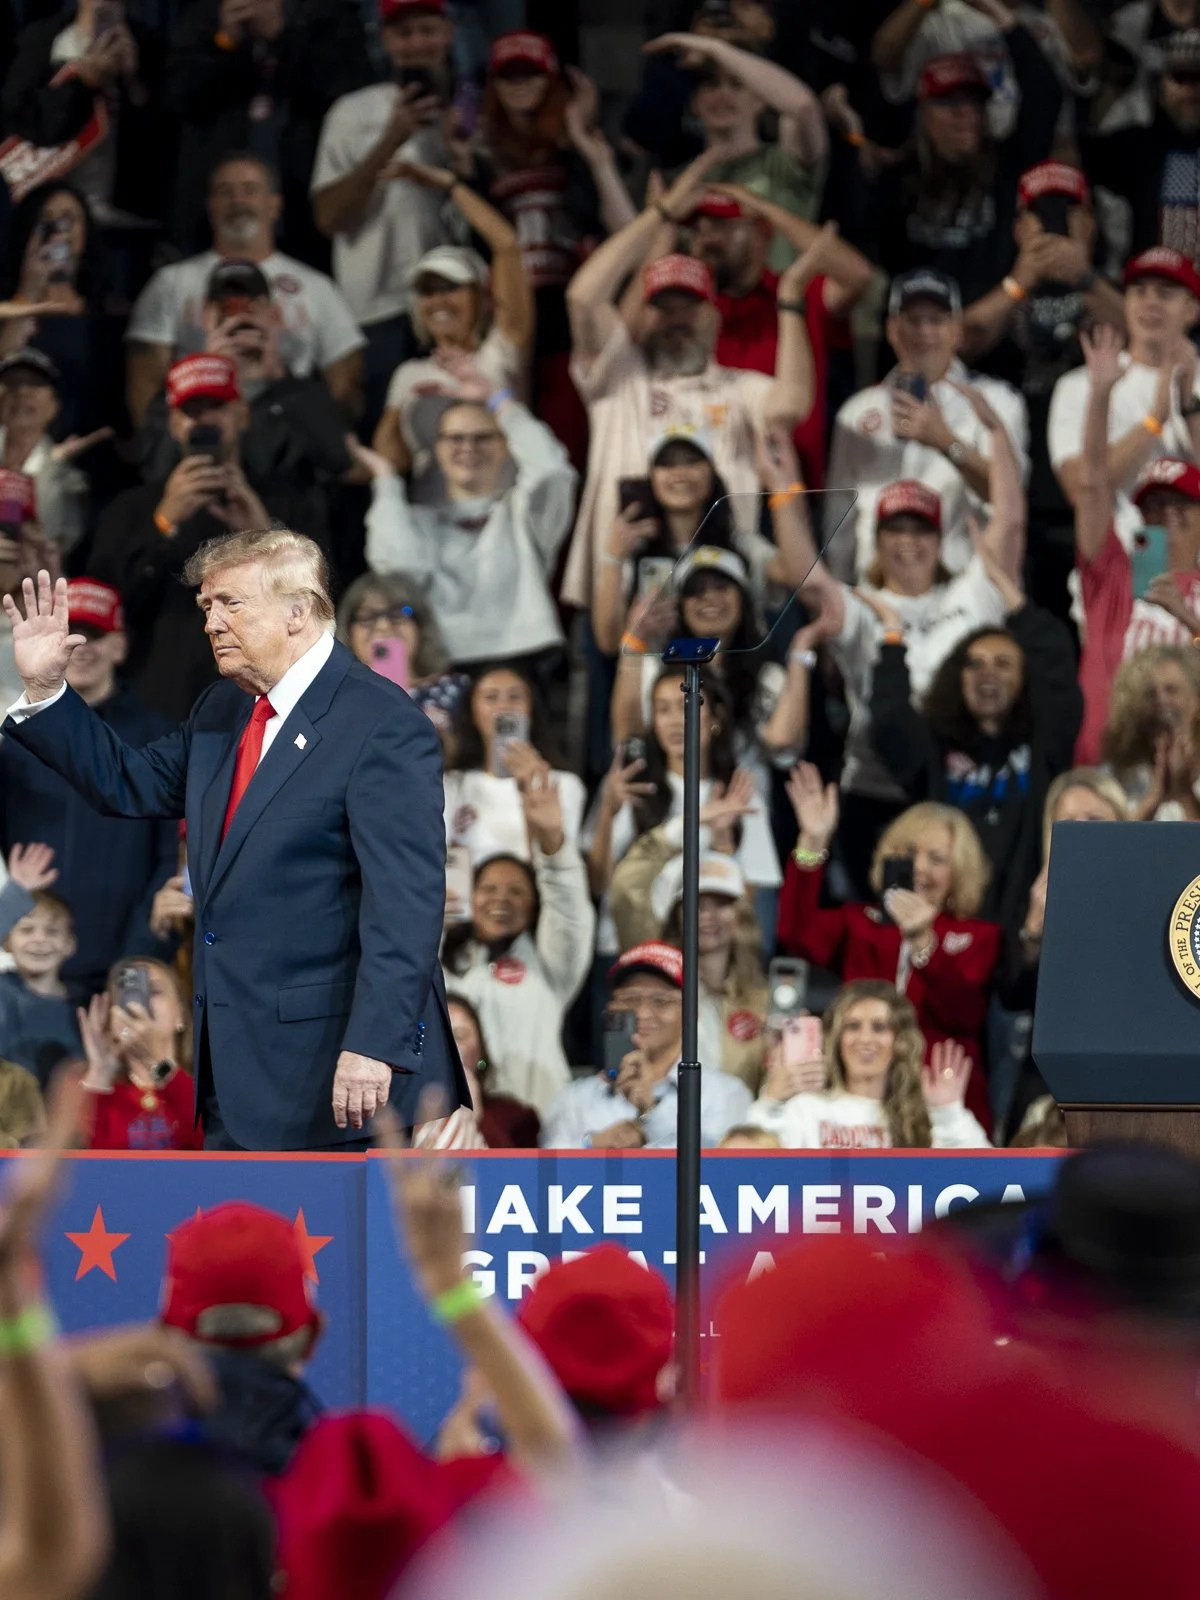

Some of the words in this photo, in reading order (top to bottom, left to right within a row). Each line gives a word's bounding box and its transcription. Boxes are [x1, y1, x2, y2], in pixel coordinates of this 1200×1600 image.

[1176, 885, 1200, 932] PRES
[1177, 938, 1189, 959] THE
[1183, 962, 1195, 976] OF
